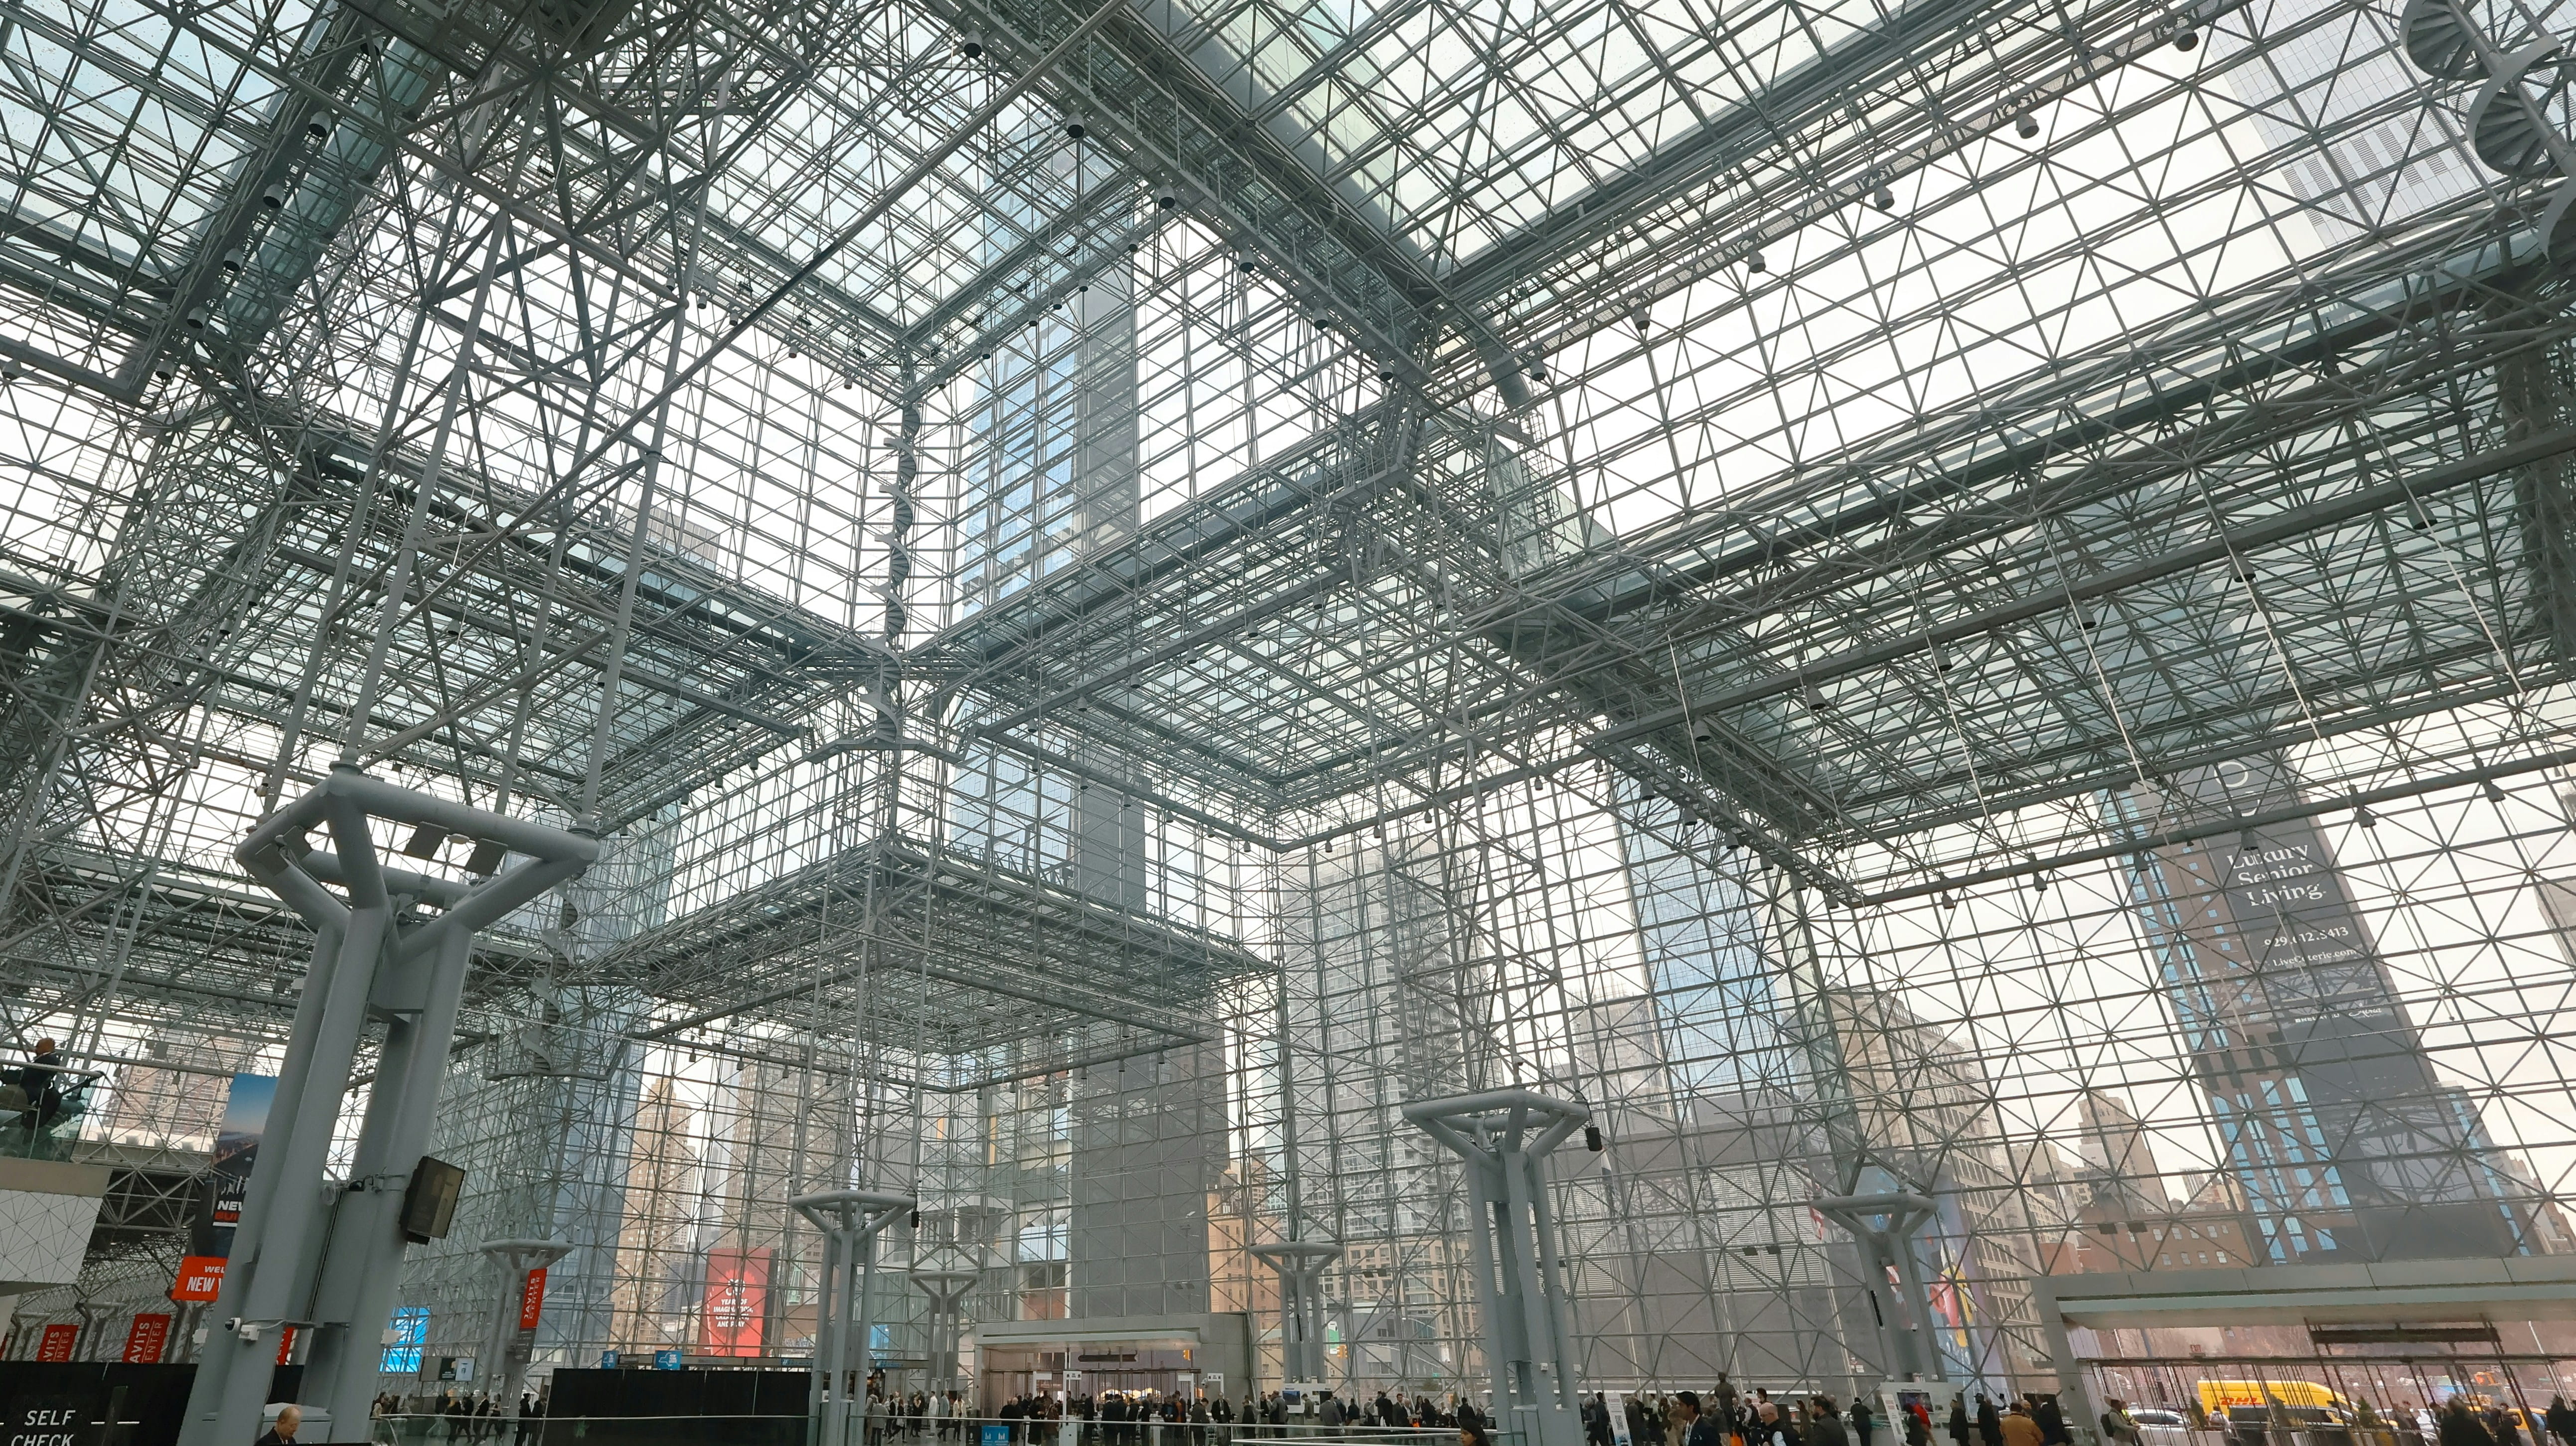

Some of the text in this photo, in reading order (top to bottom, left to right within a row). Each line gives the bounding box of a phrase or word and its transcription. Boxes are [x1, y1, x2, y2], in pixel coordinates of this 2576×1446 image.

[2227, 845, 2308, 869] Luxury
[2237, 863, 2313, 885] Senior
[186, 1277, 215, 1292] NEW
[524, 1278, 536, 1319] JAVITS
[56, 1331, 71, 1362] NTER
[2219, 1397, 2262, 1406] DHL
[24, 1410, 76, 1426] SELF
[11, 1434, 74, 1446] CHECK
